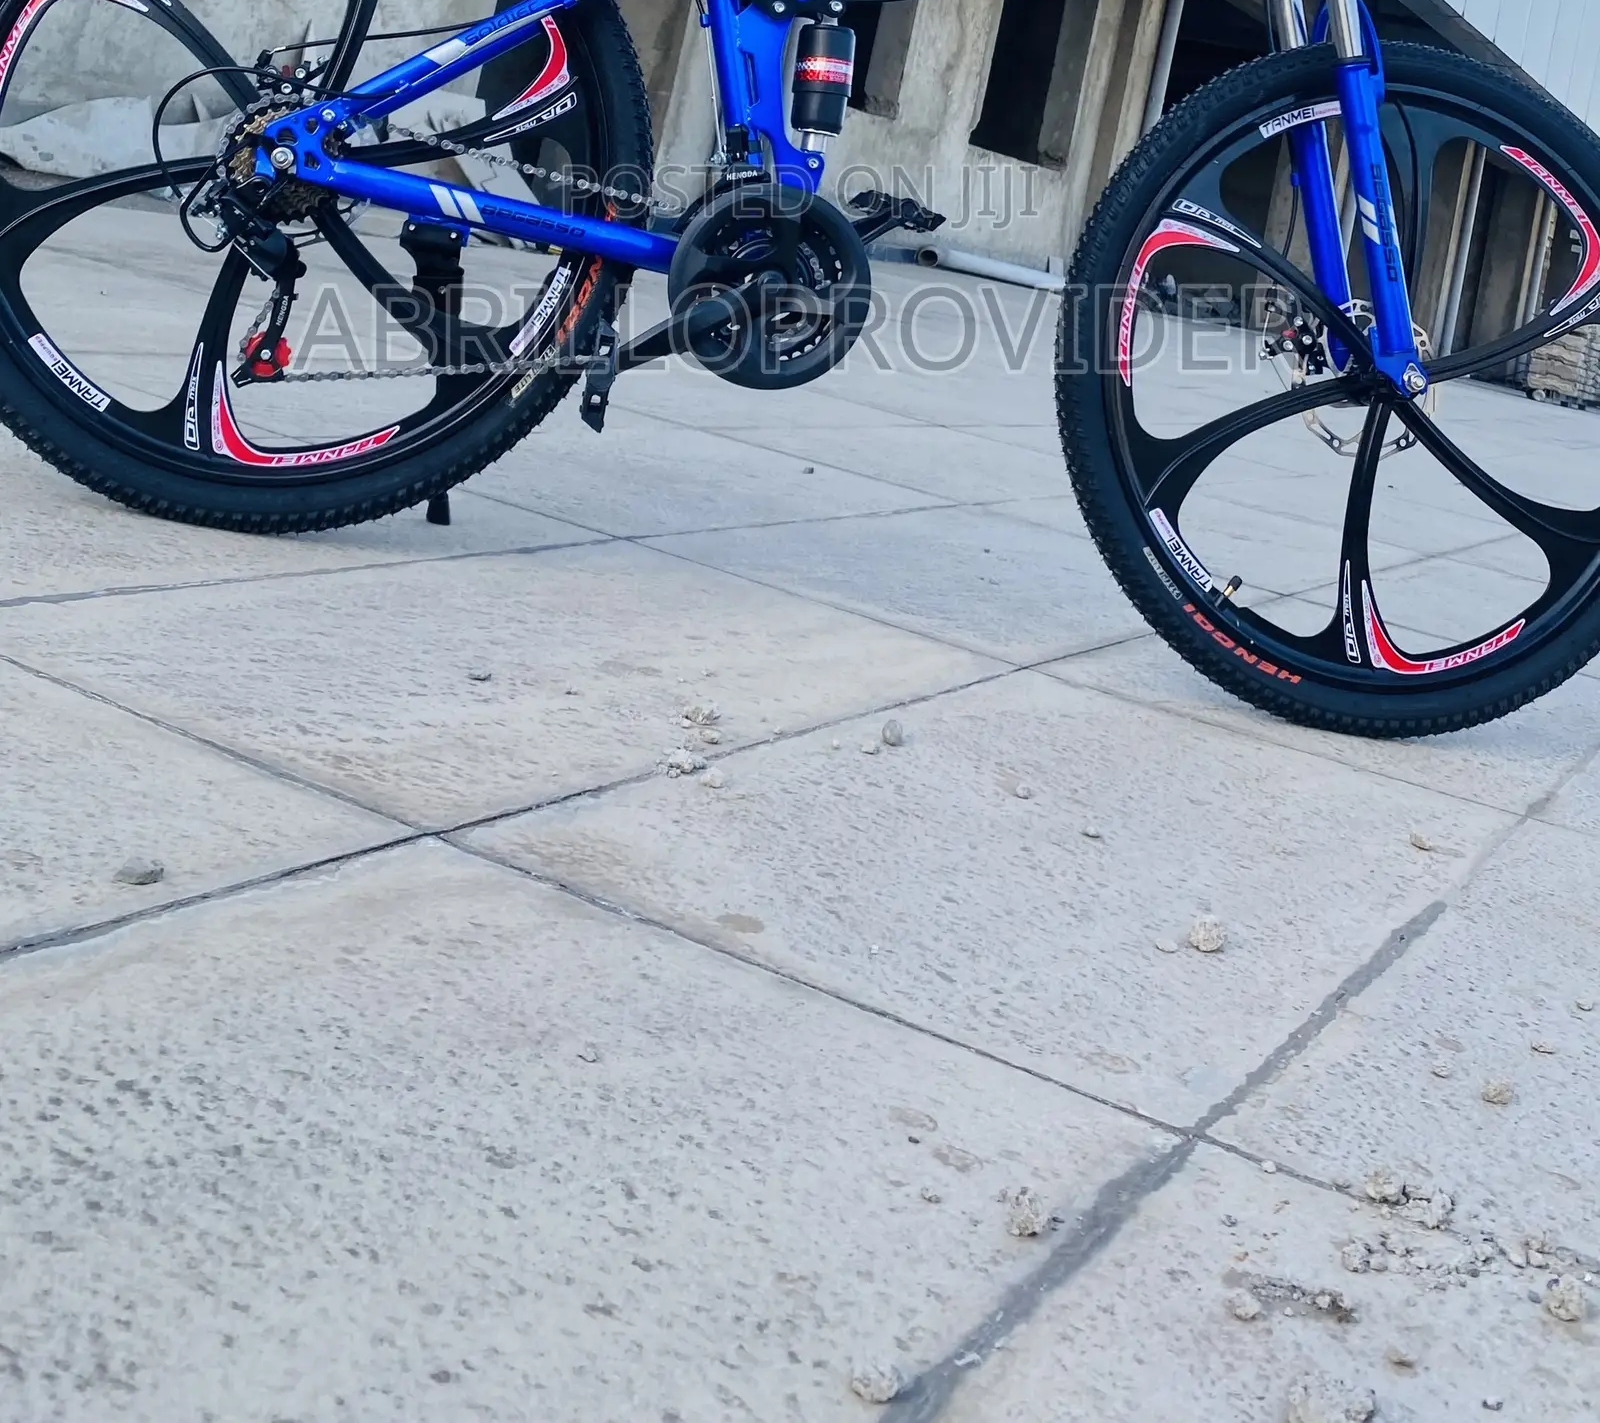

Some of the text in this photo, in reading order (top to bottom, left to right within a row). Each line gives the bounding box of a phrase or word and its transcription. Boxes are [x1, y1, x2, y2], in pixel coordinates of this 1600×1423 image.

[1263, 107, 1315, 135] TANMEI
[726, 170, 758, 180] HENGDA
[276, 295, 290, 327] HENGDA
[531, 271, 570, 326] TANMEI
[1118, 265, 1142, 361] TANMEI
[51, 360, 106, 408] TANMEI
[271, 439, 379, 466] TANMEI
[1167, 536, 1211, 589] TANMEI
[1183, 603, 1302, 684] HENGQI
[1424, 632, 1511, 672] TANMEI
